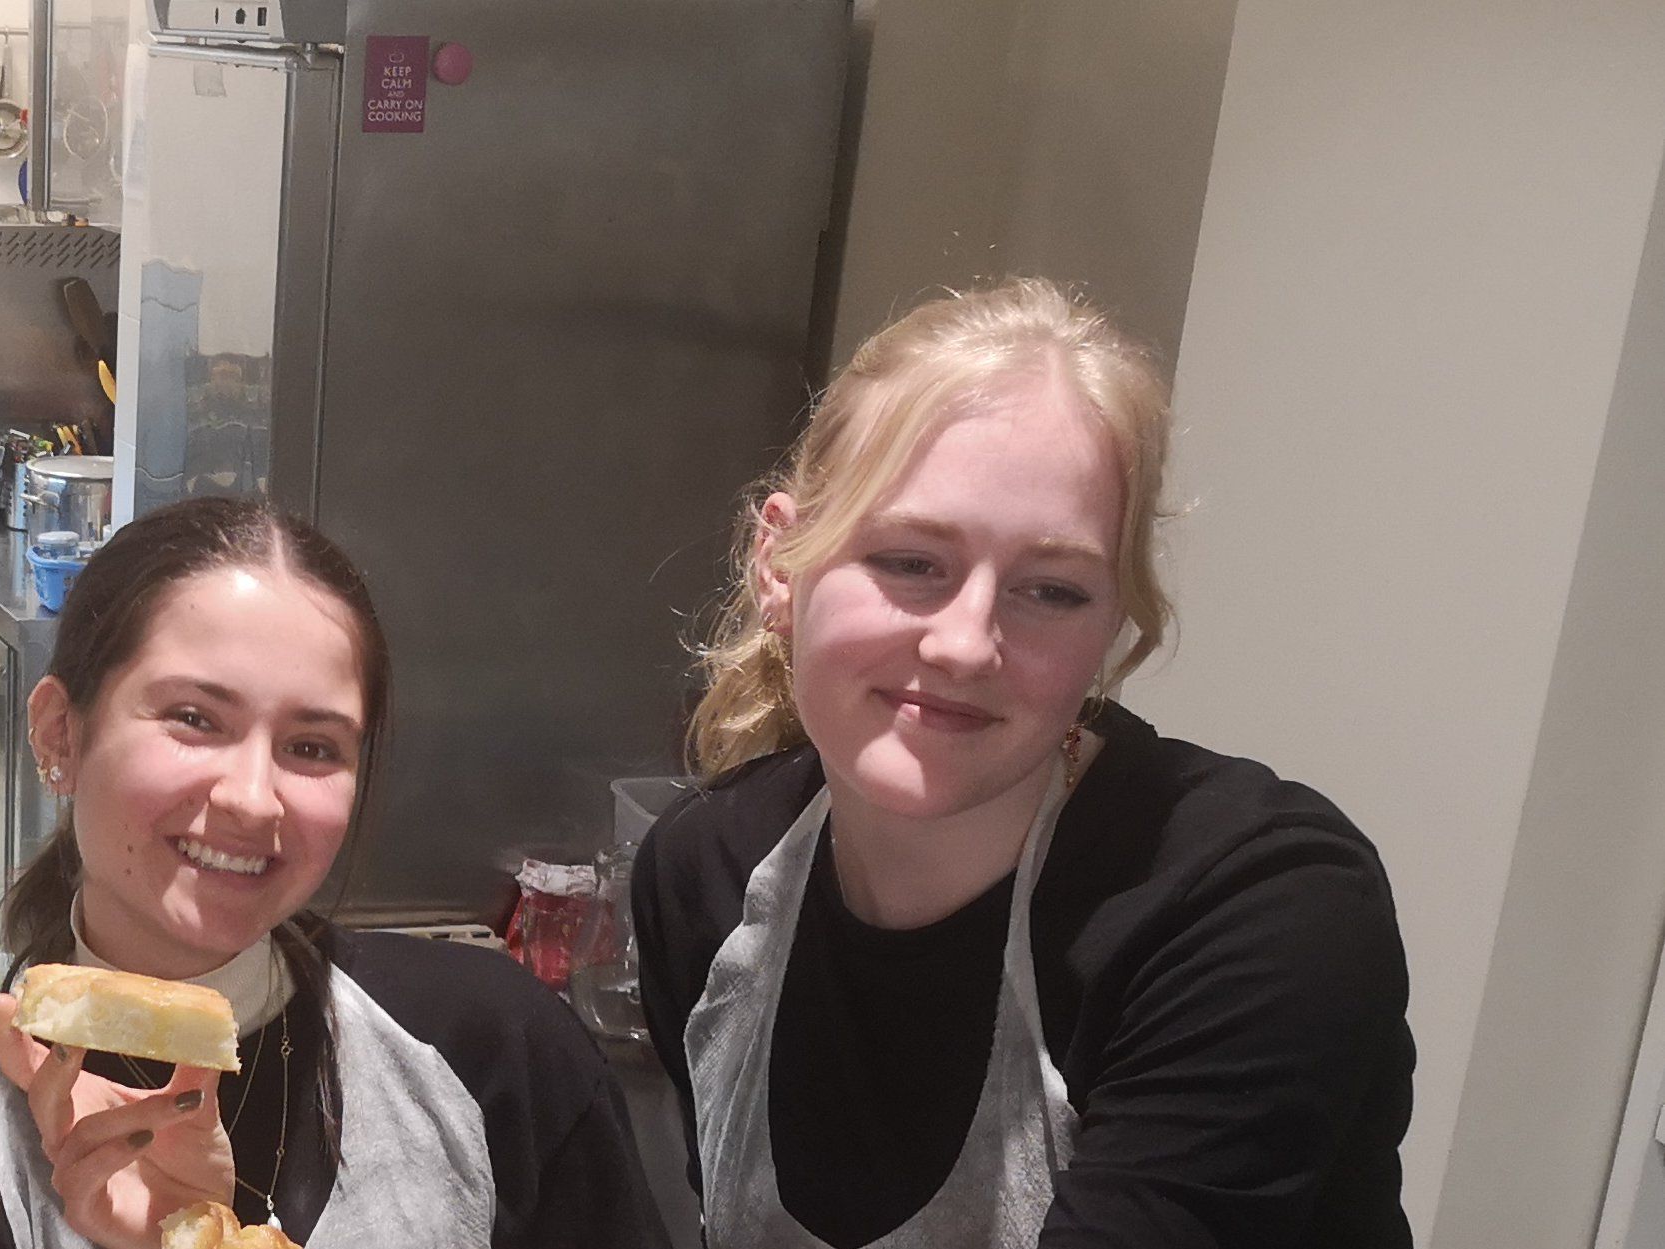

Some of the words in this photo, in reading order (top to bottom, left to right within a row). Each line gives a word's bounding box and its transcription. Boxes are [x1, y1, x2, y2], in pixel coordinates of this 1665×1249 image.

[384, 66, 412, 77] KEEP
[381, 79, 412, 89] CALM
[387, 90, 405, 98] AND
[367, 99, 402, 110] CARRY
[405, 99, 423, 109] ON
[367, 111, 422, 122] COOKING
